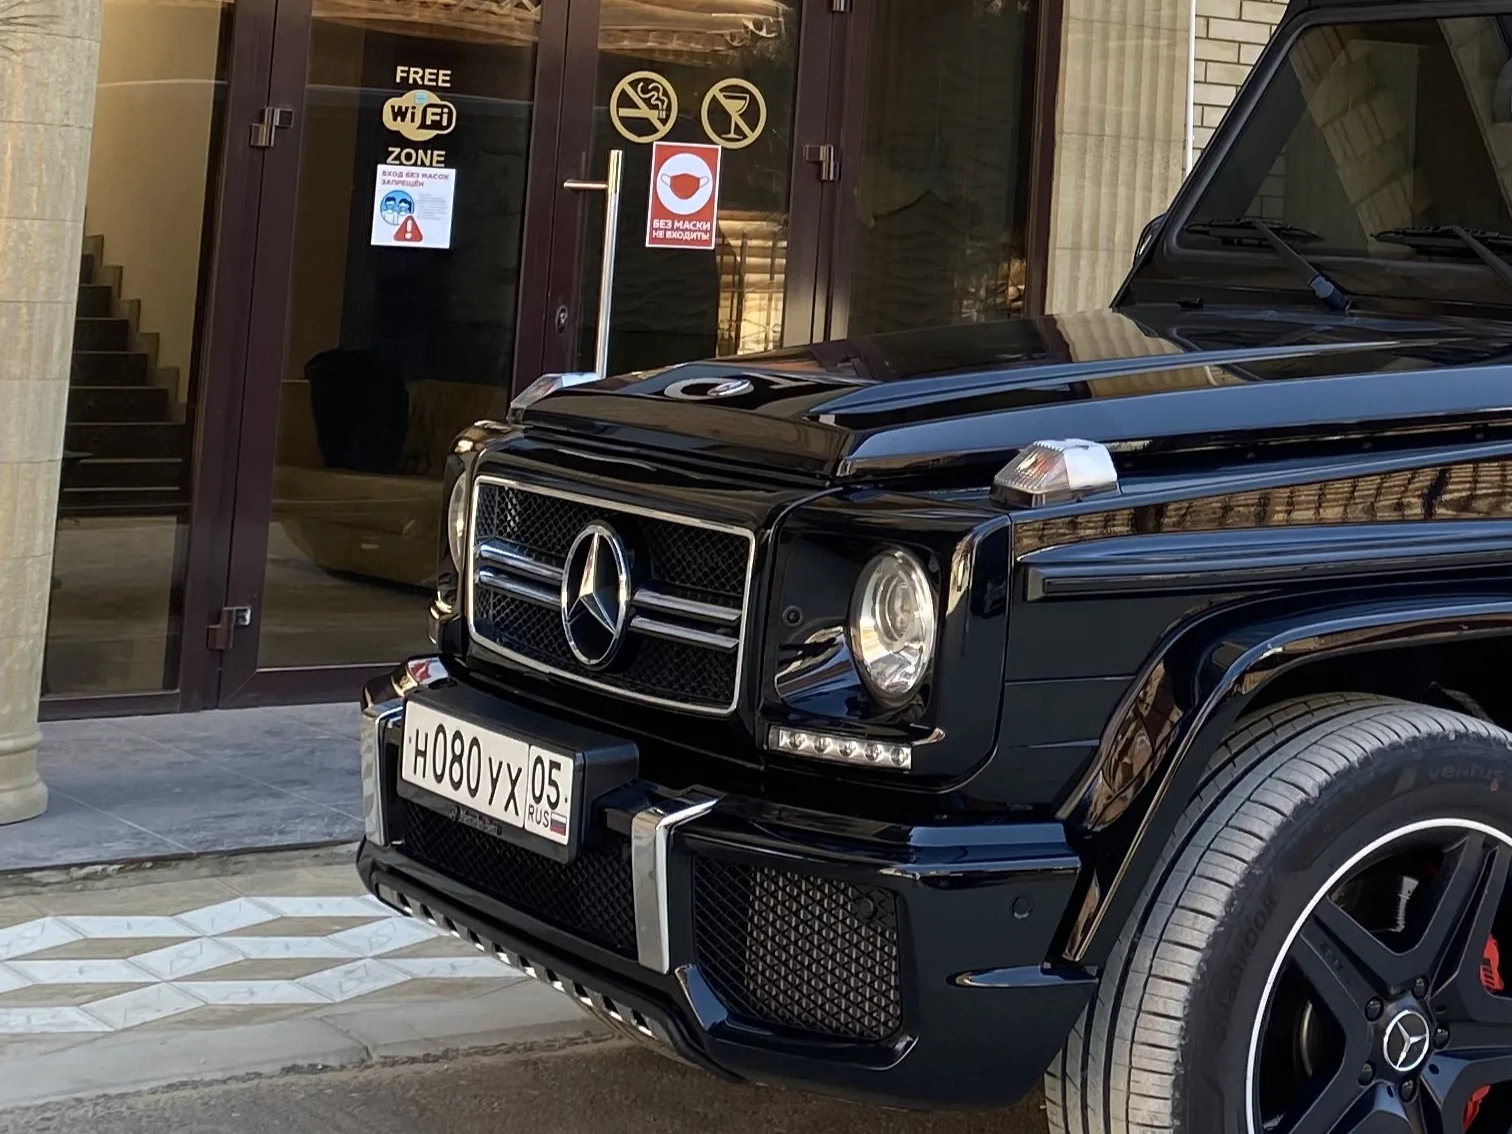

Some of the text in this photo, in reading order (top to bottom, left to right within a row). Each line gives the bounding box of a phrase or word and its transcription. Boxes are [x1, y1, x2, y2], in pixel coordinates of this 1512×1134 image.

[396, 66, 451, 87] FREE
[386, 147, 446, 167] ZONE
[381, 170, 403, 178] ВХОД
[421, 172, 449, 181] МАСОК
[652, 230, 664, 238] НЕ
[653, 219, 711, 230] БЕЗ МАСКИ
[531, 755, 562, 811] 05
[528, 804, 549, 828] RUS
